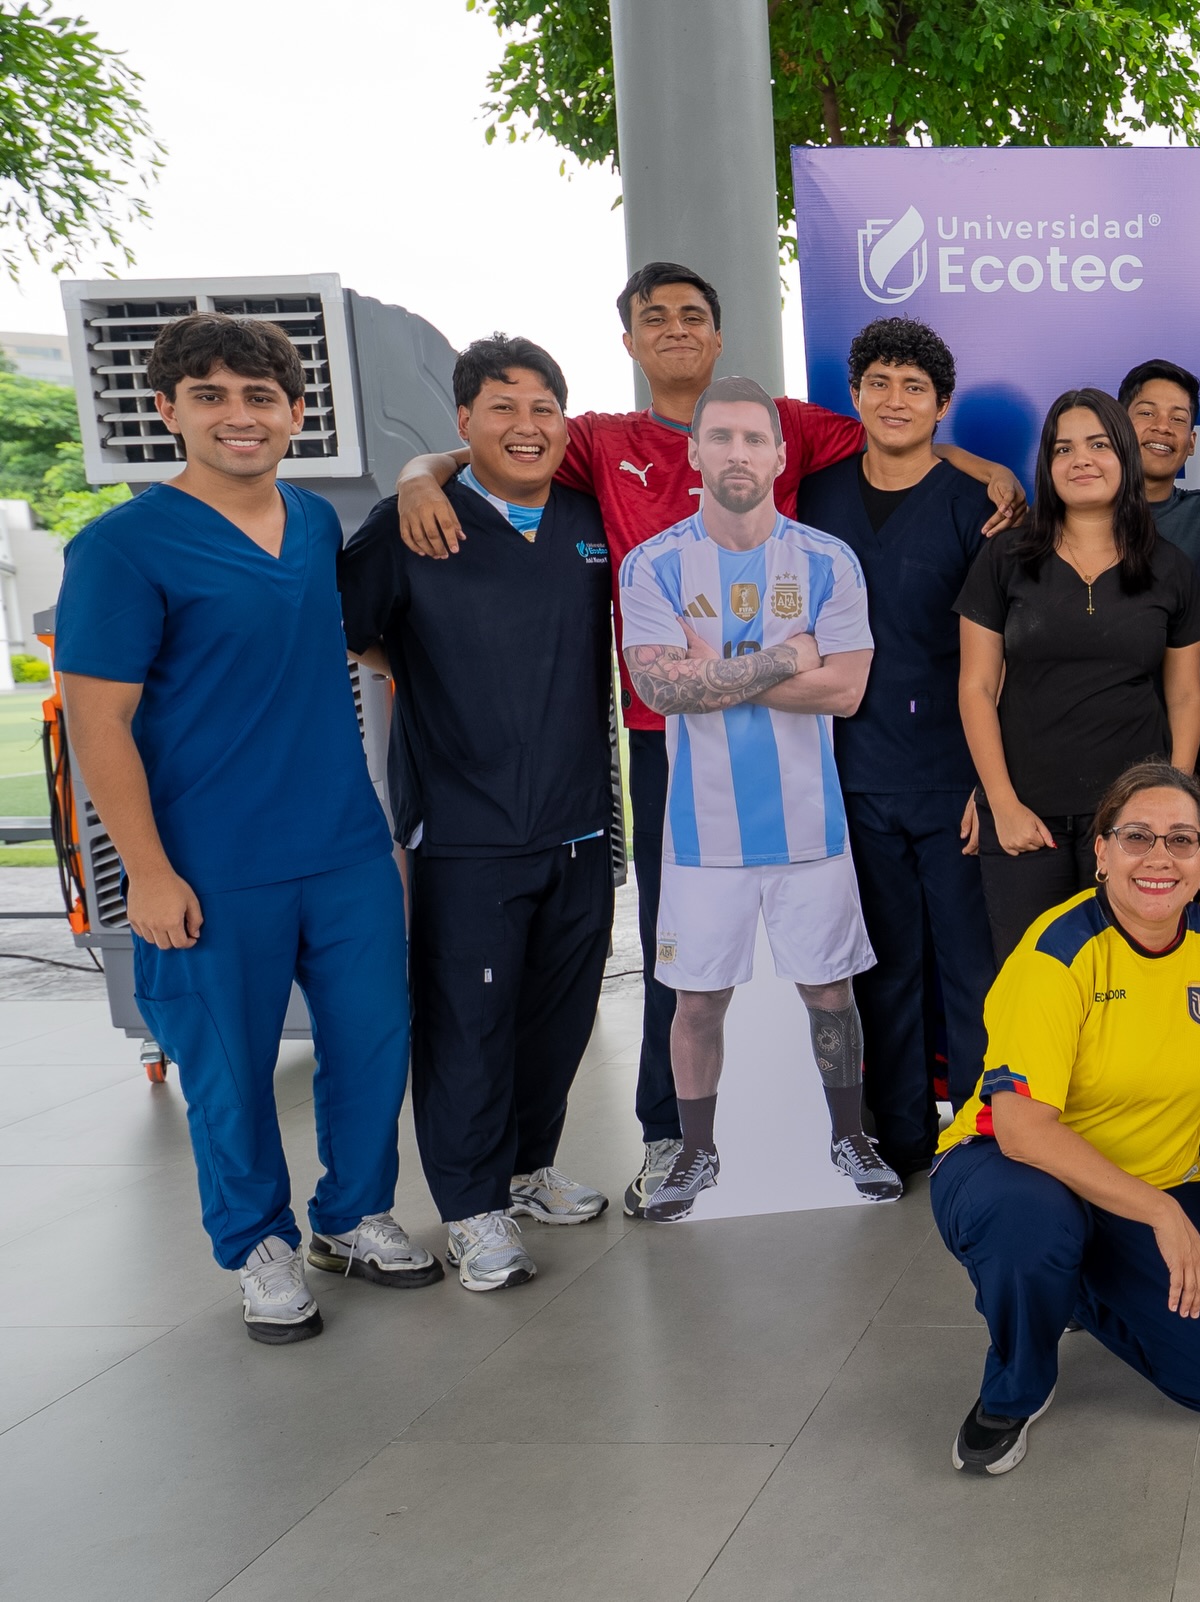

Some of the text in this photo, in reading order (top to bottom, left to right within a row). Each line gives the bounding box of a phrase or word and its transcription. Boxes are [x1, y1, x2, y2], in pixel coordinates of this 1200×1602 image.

[938, 246, 1144, 293] Ecotec
[777, 592, 797, 609] AFA
[1094, 989, 1127, 1003] ECADOR
